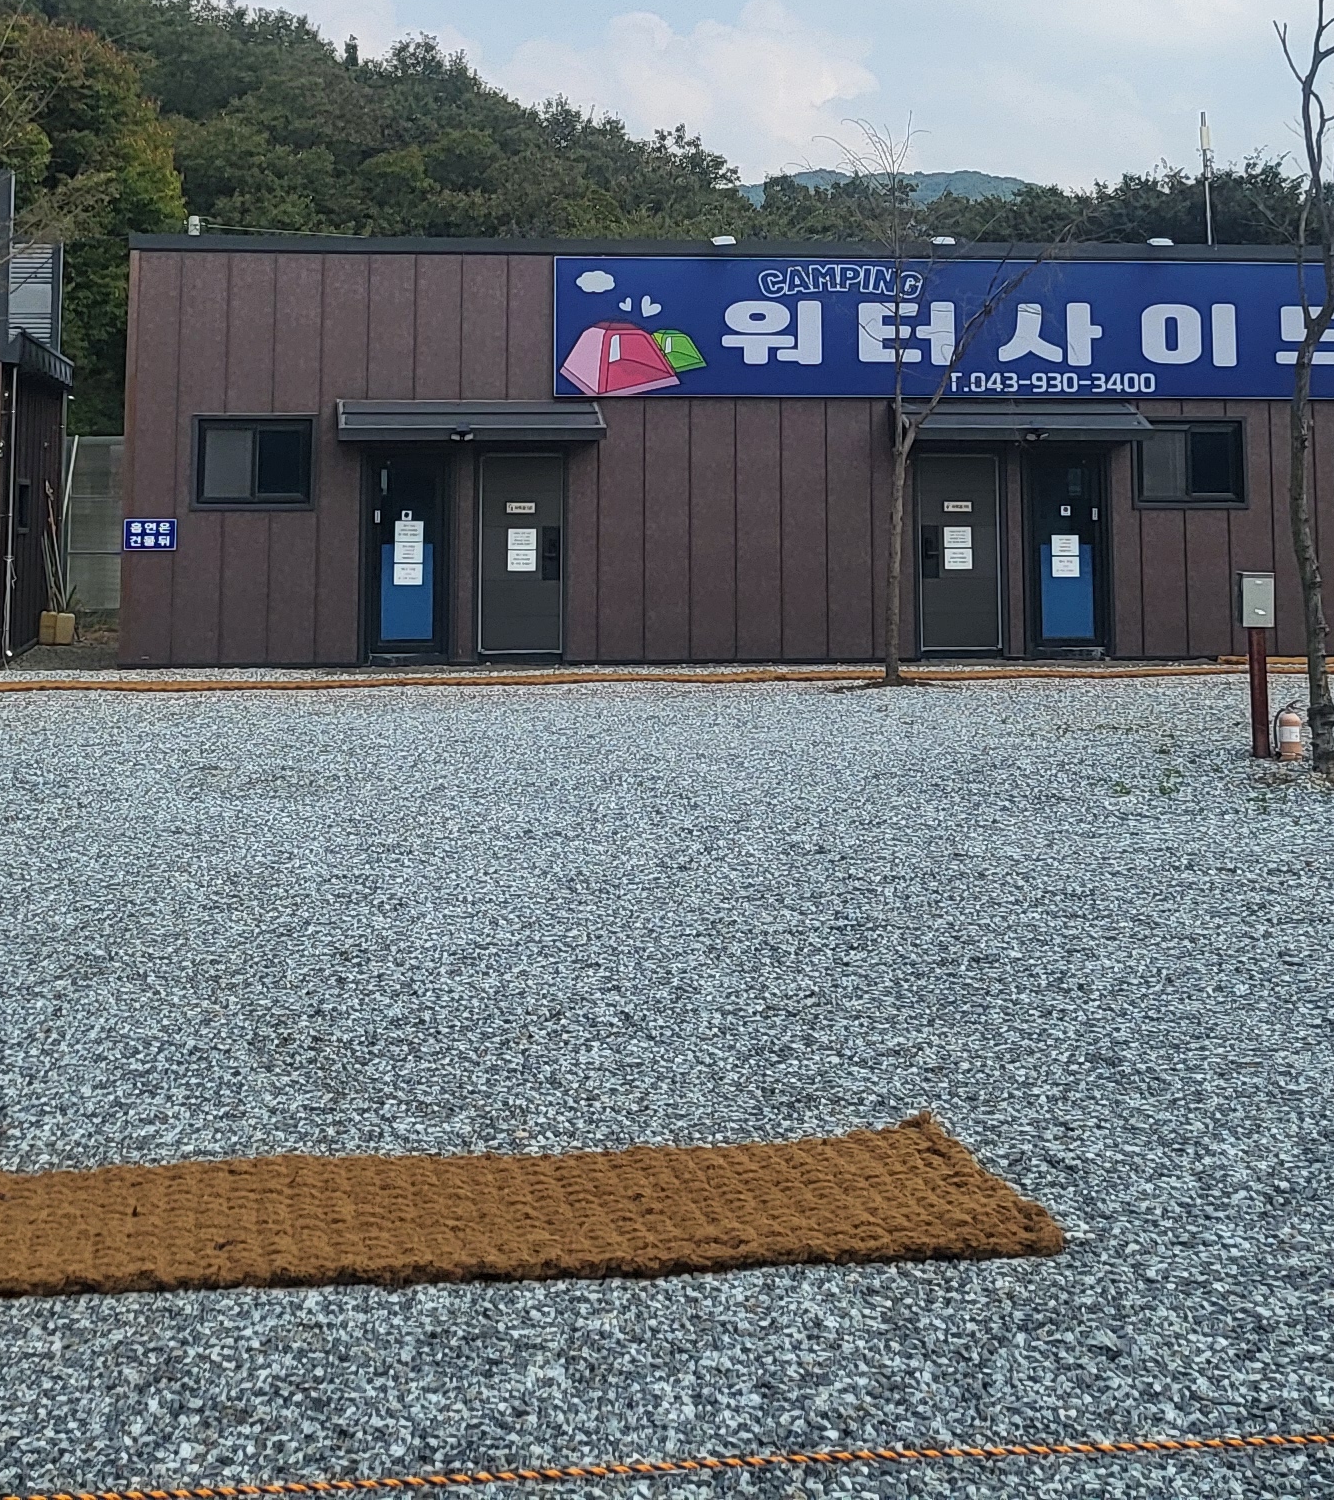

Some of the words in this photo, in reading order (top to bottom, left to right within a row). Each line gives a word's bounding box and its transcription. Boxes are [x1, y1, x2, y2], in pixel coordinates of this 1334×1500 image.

[758, 264, 923, 298] CAMPING
[950, 372, 1156, 393] T.043-930-3400
[130, 522, 171, 533] 흡연은
